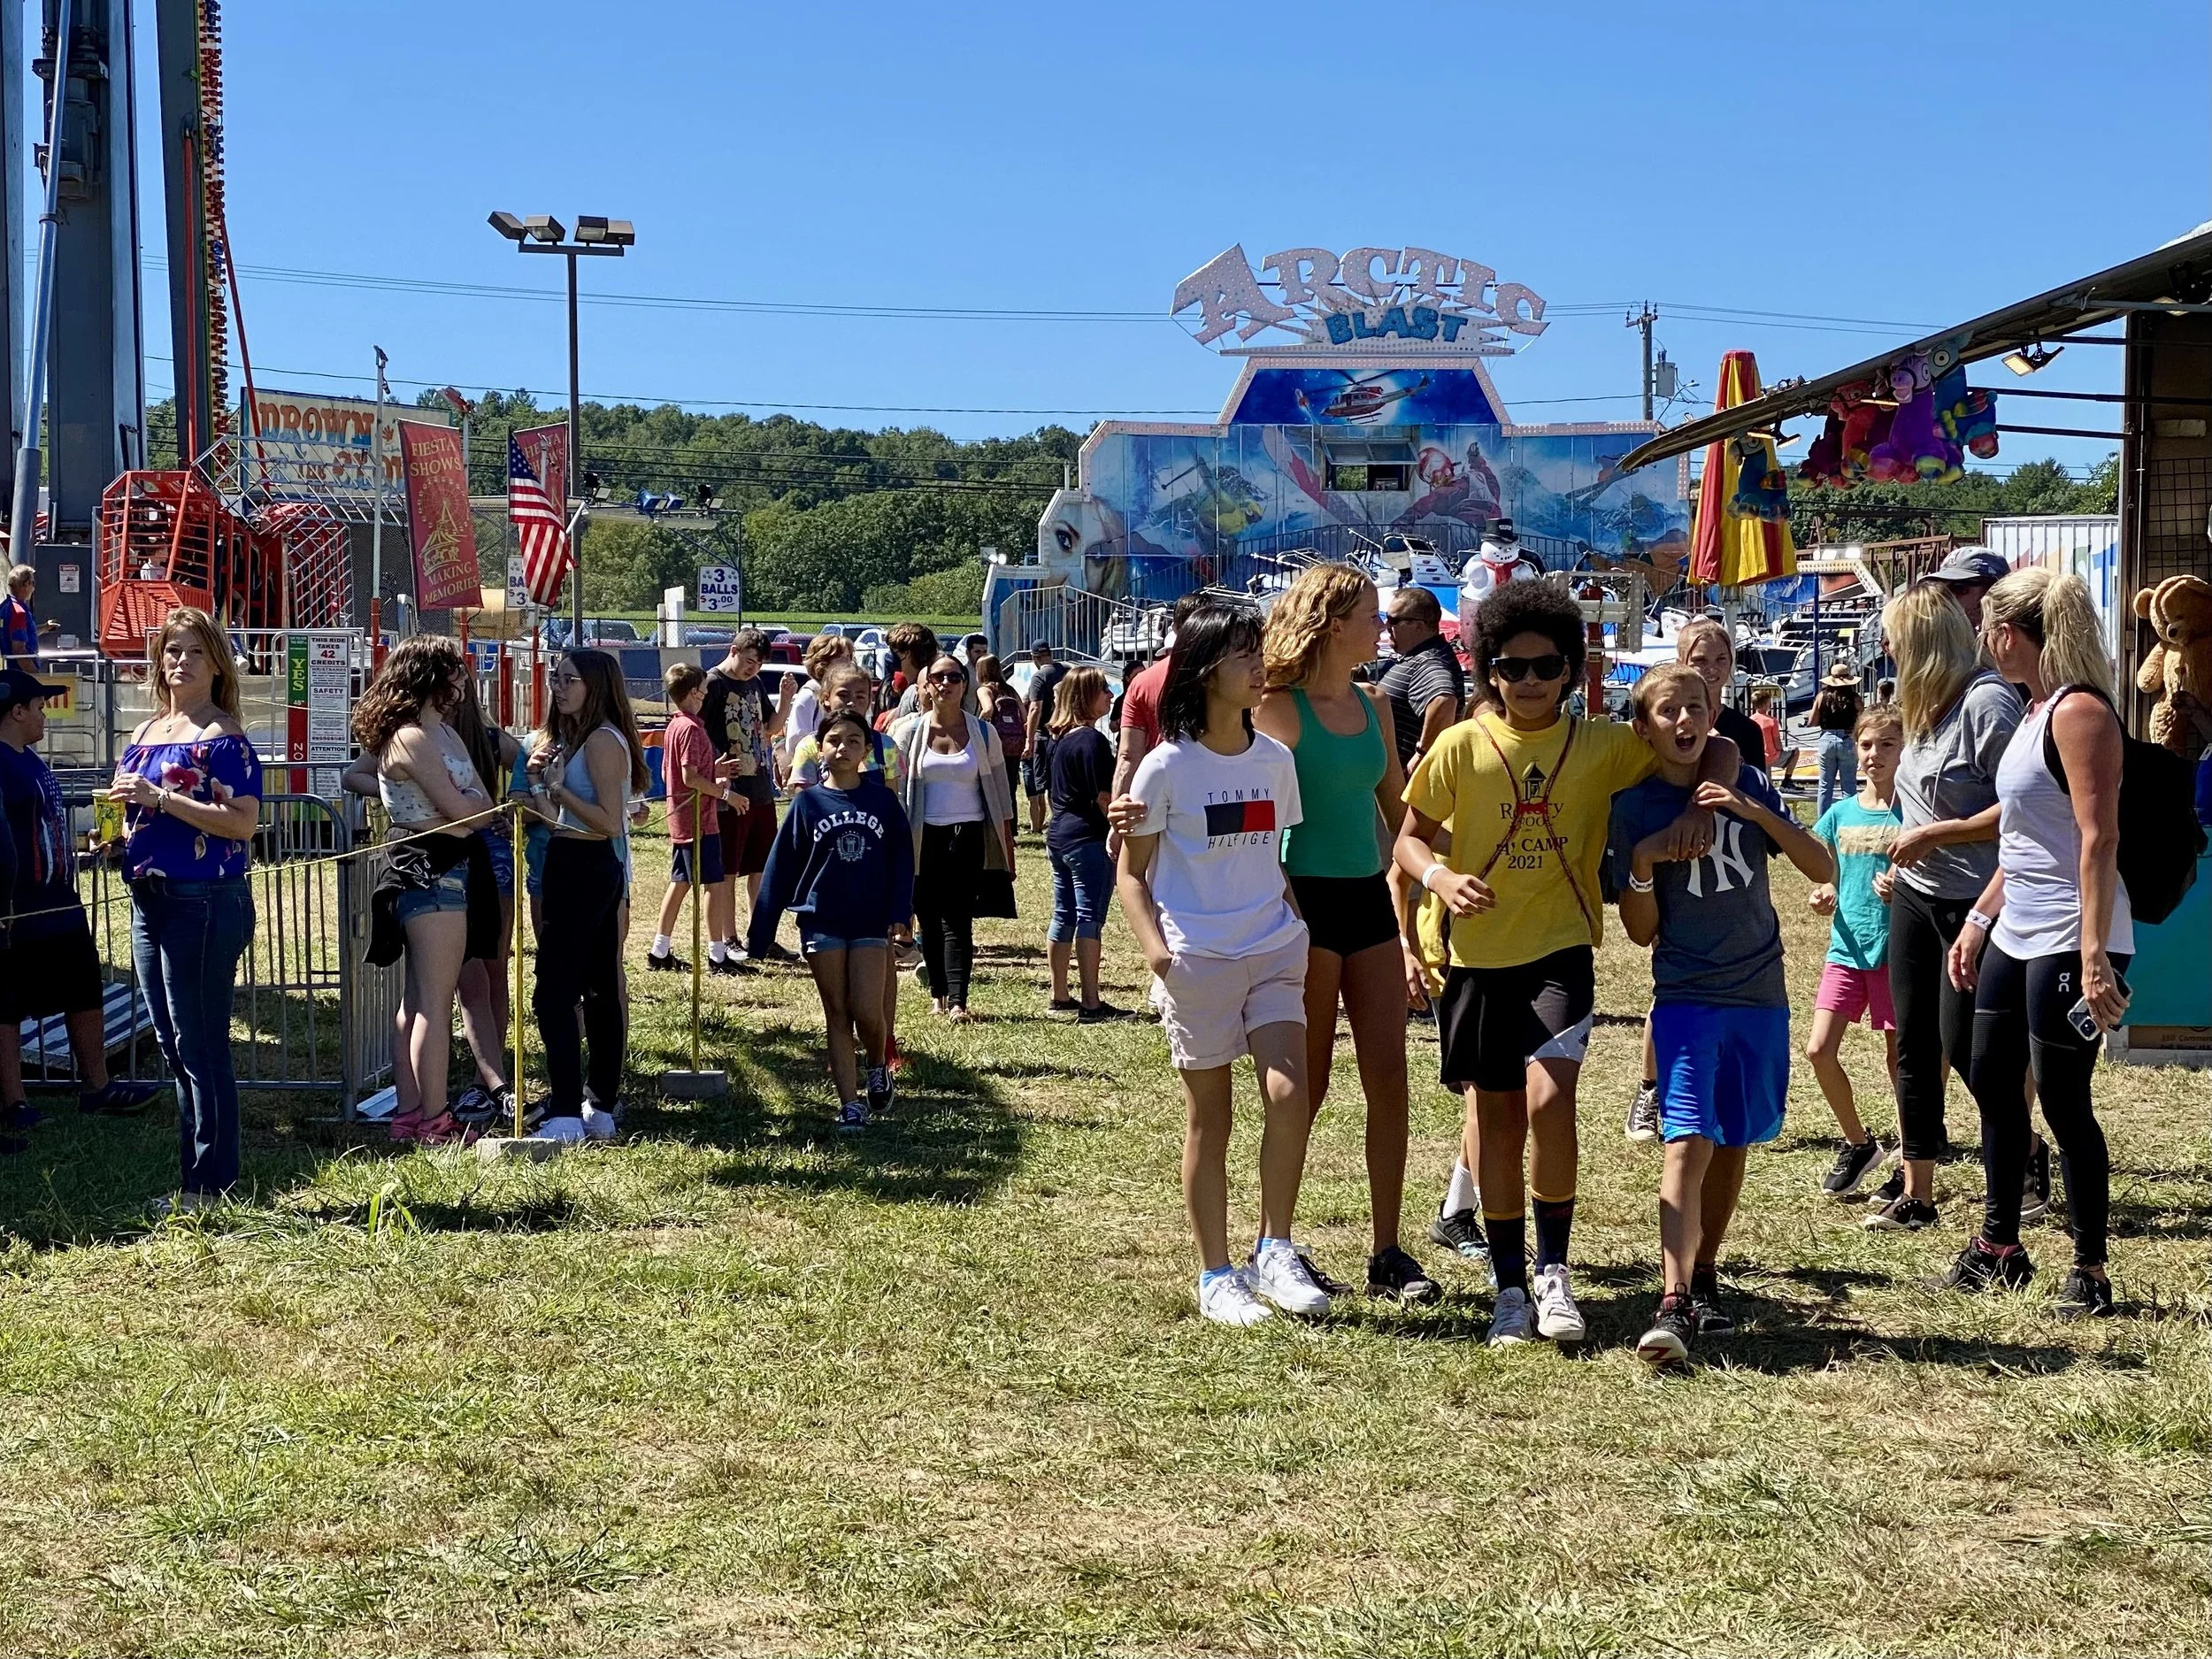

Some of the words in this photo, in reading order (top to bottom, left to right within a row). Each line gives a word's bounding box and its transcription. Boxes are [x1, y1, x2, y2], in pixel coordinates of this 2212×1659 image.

[1170, 243, 1550, 346] ARCTIC
[1325, 306, 1468, 345] BLAST
[259, 402, 374, 453] DROWN
[411, 438, 456, 457] FIESTA
[411, 457, 462, 478] SHOWS
[427, 561, 472, 587] MAKING
[714, 568, 726, 583] 3
[424, 576, 479, 604] MEMORIES
[701, 583, 738, 595] BALLS
[320, 650, 336, 659] 42
[291, 658, 306, 691] YES
[293, 742, 304, 761] NO
[1207, 787, 1270, 804] TOMMY
[813, 810, 885, 842] COLLEGE
[1207, 831, 1275, 849] HILFIGE
[1521, 836, 1569, 852] CAMP
[1507, 855, 1543, 870] 2021
